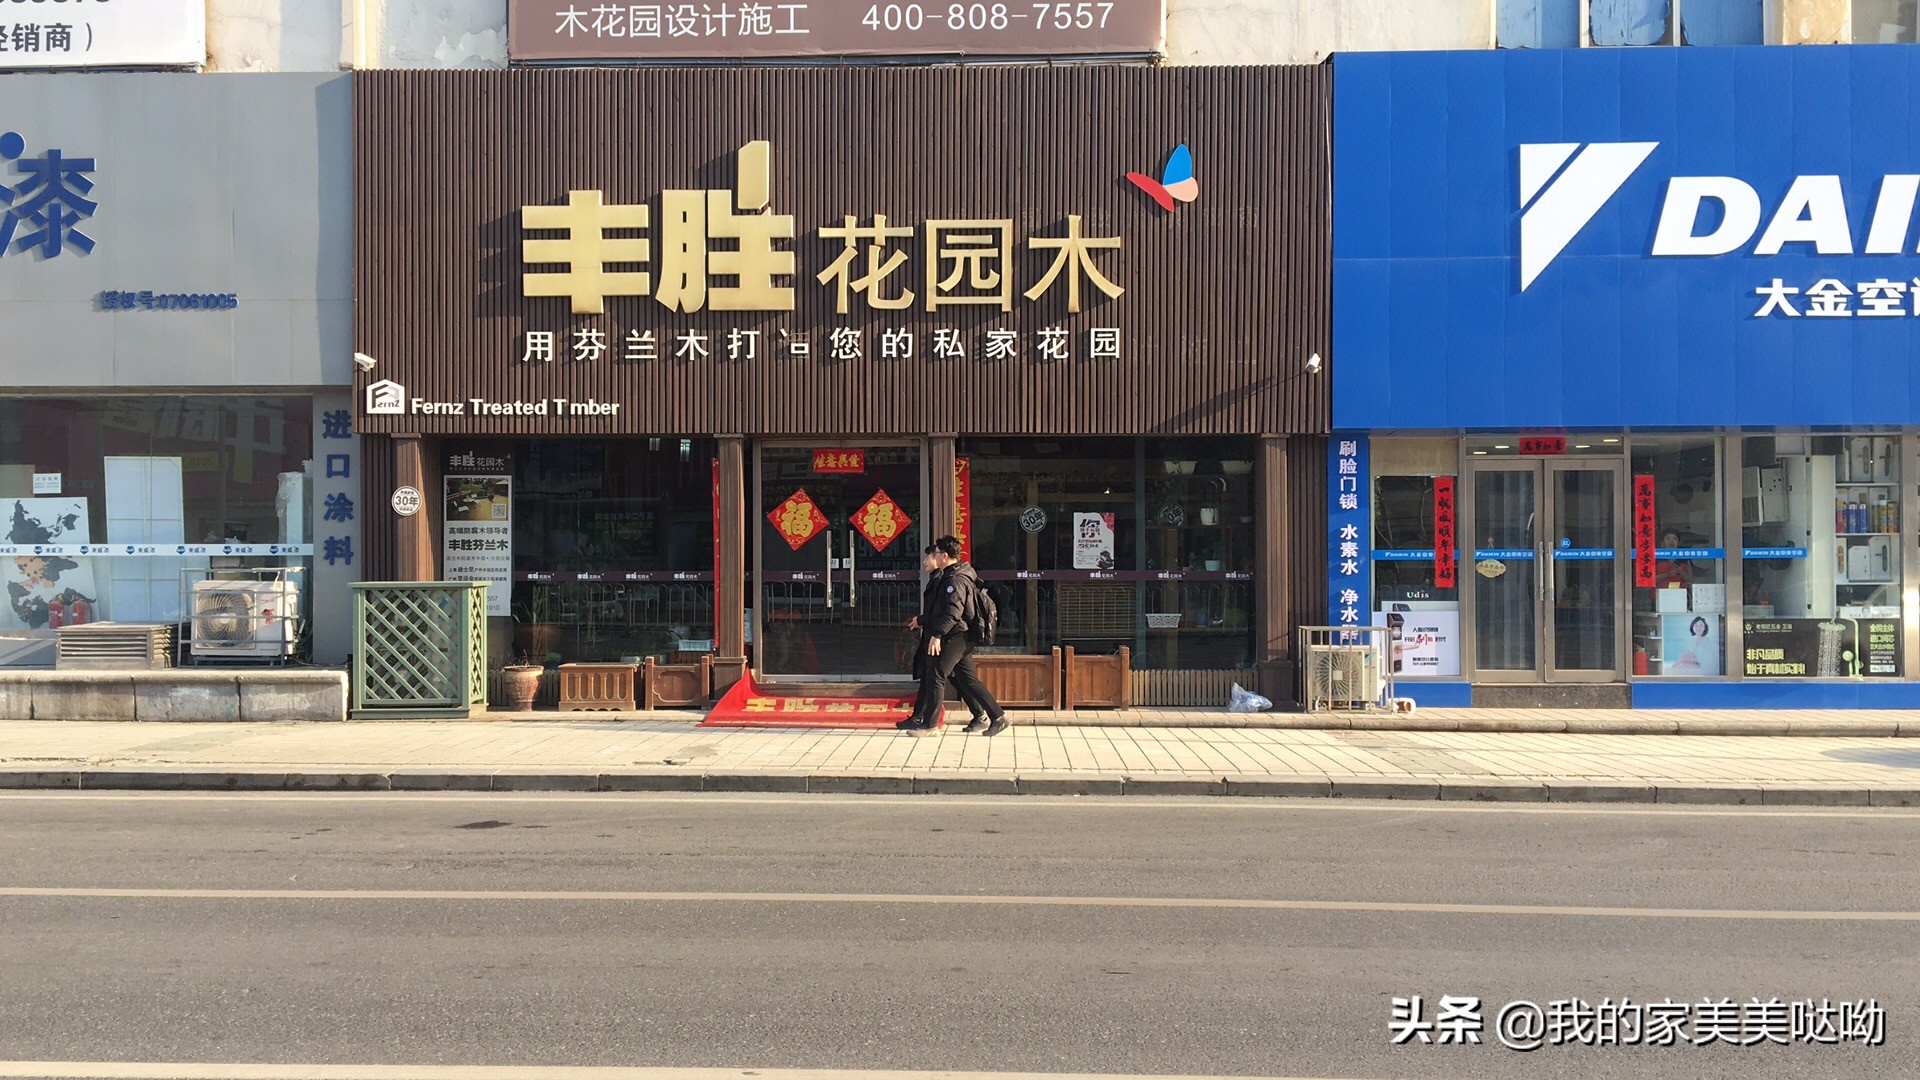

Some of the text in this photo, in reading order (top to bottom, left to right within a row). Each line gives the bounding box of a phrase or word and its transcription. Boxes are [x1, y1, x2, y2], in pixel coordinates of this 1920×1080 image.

[555, 3, 1114, 37] 木花园设计施工 400-808-7557
[1652, 174, 1920, 255] DAI
[411, 398, 464, 415] Fernz
[469, 399, 547, 415] Treated
[322, 410, 354, 565] 进口涂料
[1339, 441, 1358, 510] 刷脸门锁
[780, 500, 814, 538] 福
[863, 502, 897, 539] 福
[448, 539, 509, 551] 丰胜芬兰木
[1340, 524, 1359, 576] 水素水
[1406, 589, 1430, 599] Udis
